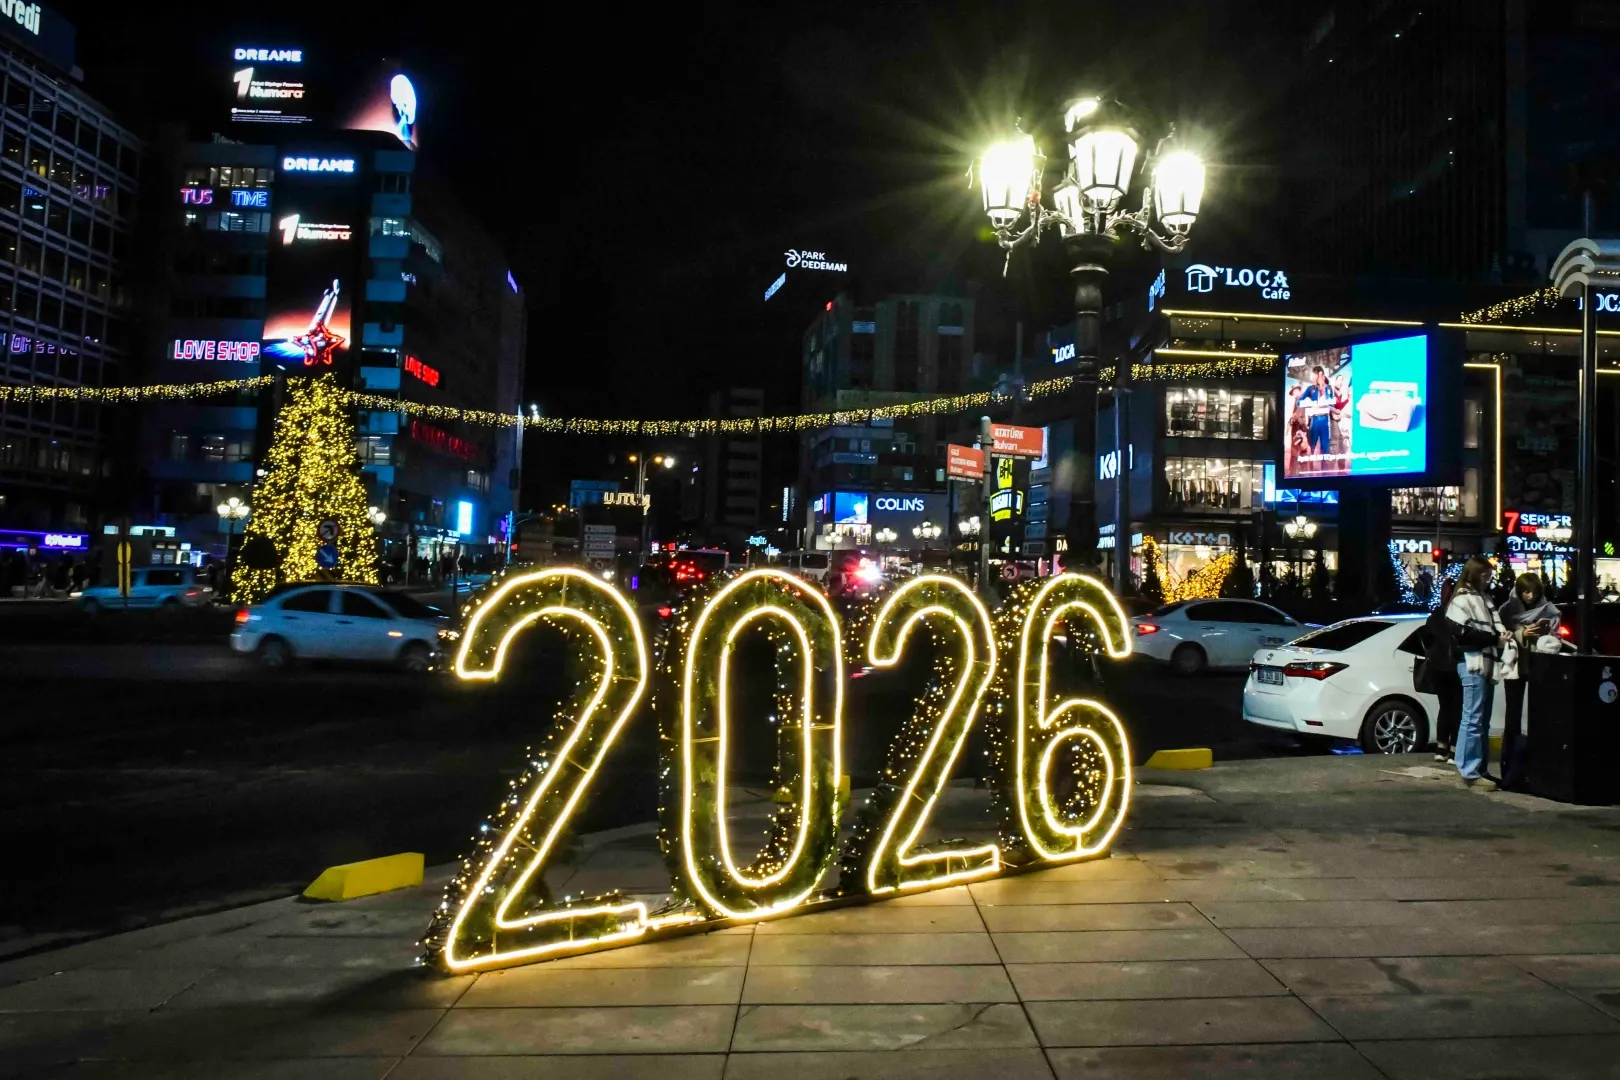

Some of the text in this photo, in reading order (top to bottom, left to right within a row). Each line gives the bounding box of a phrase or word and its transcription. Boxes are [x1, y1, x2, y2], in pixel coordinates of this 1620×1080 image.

[234, 48, 302, 62] DREAME
[249, 86, 304, 98] Numara
[283, 157, 355, 172] DREAME
[180, 188, 214, 205] TUS
[801, 250, 826, 261] PARK
[801, 259, 847, 272] DEDEMAN
[1225, 268, 1289, 288] LOCA
[1262, 287, 1291, 300] Cafe
[174, 339, 260, 362] LOVE SHOP
[1054, 344, 1076, 363] LOCA
[994, 426, 1024, 440] ATATÜRK
[875, 497, 925, 512] COLIN'S
[1504, 511, 1520, 534] 7
[1524, 541, 1554, 552] LOCA
[445, 566, 1134, 973] 2026
